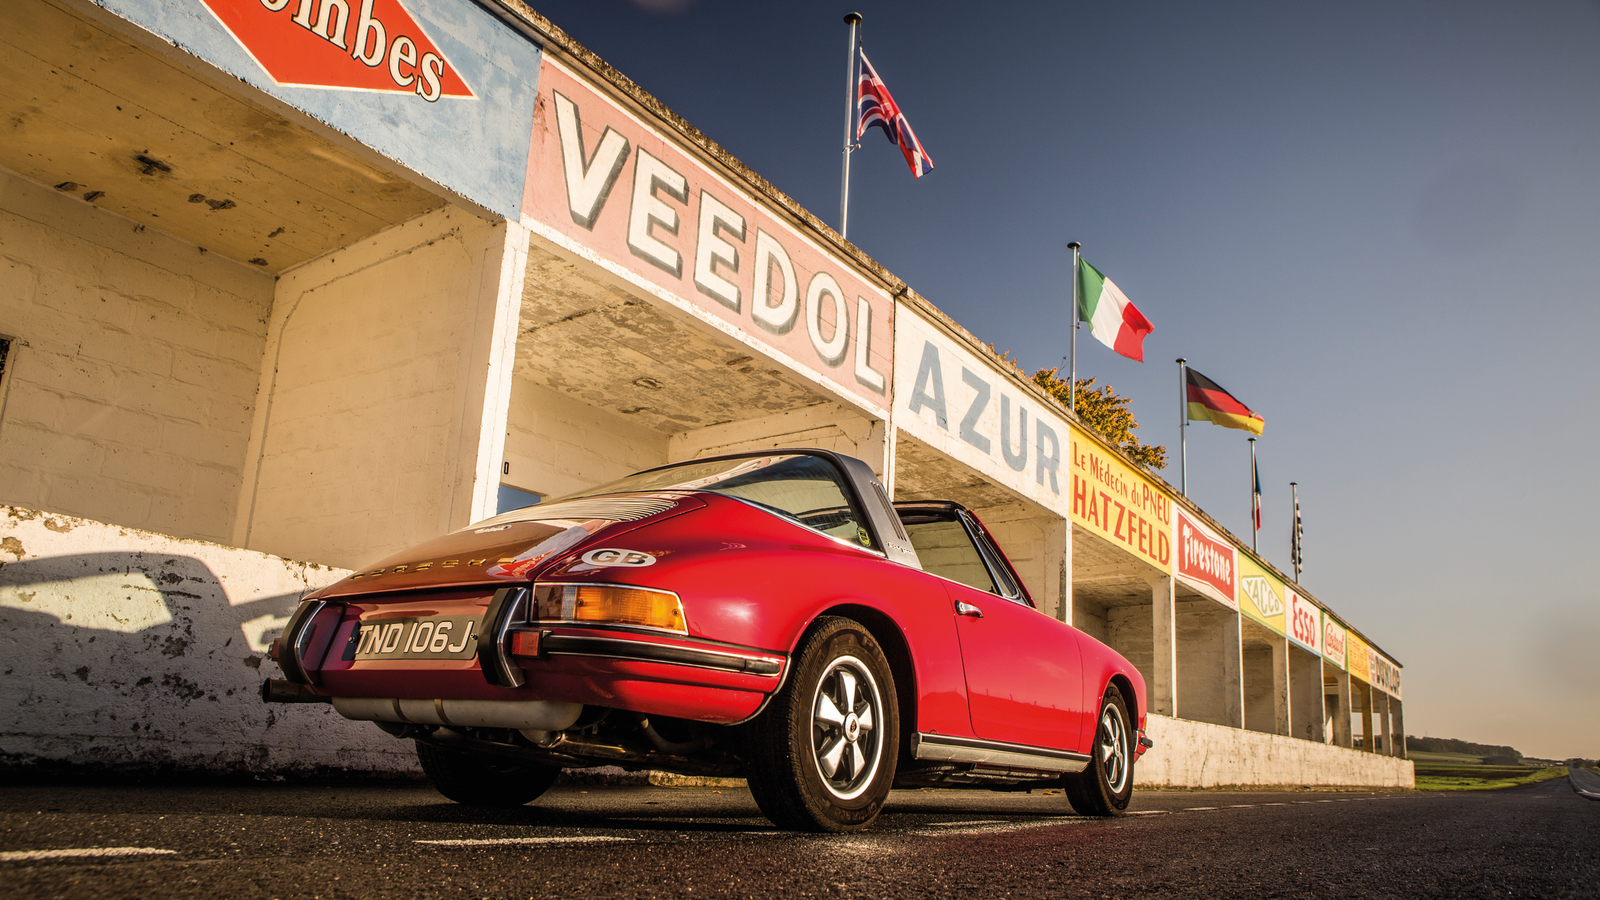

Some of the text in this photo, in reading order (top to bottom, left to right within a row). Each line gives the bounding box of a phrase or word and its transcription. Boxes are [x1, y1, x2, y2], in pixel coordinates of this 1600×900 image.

[259, 0, 444, 102] mbes
[552, 89, 887, 397] VEEDOL
[909, 339, 1062, 498] AZUR
[1073, 474, 1170, 566] HATZFELD
[1143, 482, 1170, 526] PNEU
[350, 557, 517, 580] PORSCHE
[590, 550, 649, 567] GB
[1182, 523, 1231, 586] Firestone
[1246, 579, 1280, 614] YACCO
[355, 620, 475, 655] TND 106J
[1375, 655, 1400, 696] DUNLOP
